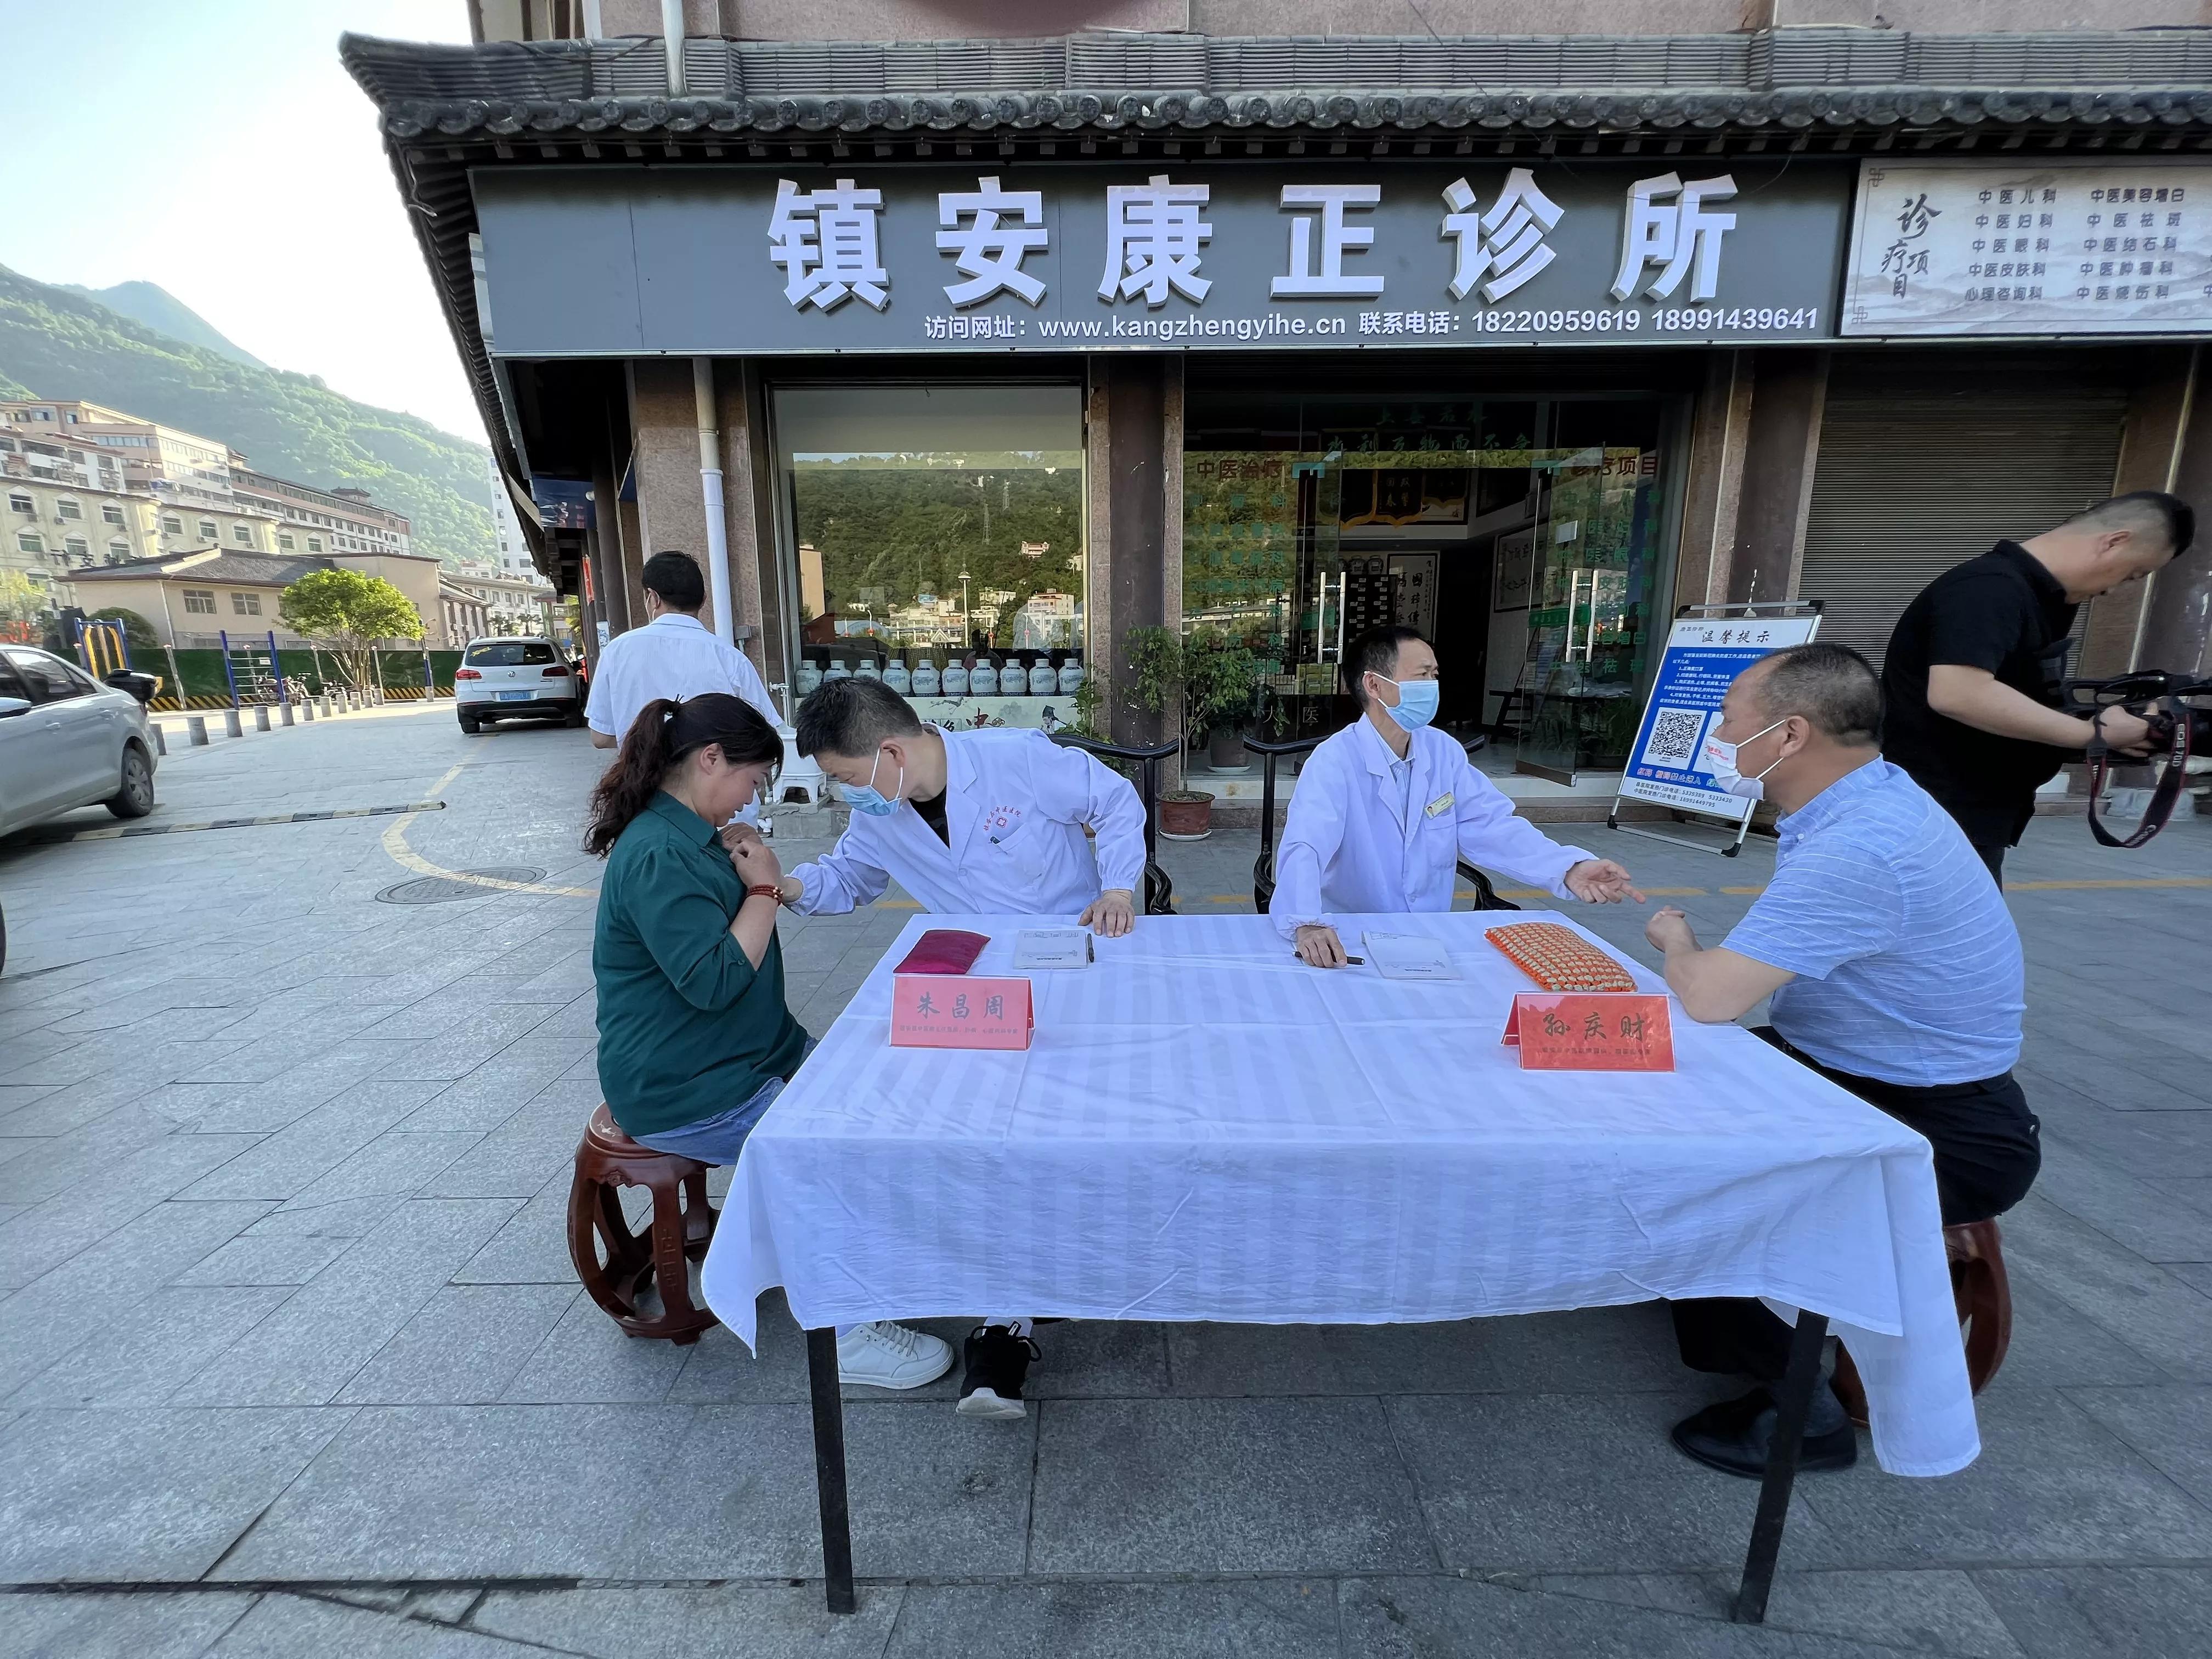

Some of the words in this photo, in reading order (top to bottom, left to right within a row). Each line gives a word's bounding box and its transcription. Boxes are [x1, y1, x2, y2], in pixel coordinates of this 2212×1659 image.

[1979, 189, 2057, 204] 中医儿科
[768, 167, 1738, 312] 镇安康正诊所
[1969, 262, 2046, 278] 中医皮肤科
[1038, 313, 1347, 343] www.kangzhengyihe.cn
[1472, 309, 1640, 333] 18220959619
[1652, 307, 1818, 330] 18991439641
[1702, 629, 1770, 644] 温馨提示
[916, 991, 1004, 1020] 朱昌周
[1543, 1012, 1646, 1042] 孙庆财
